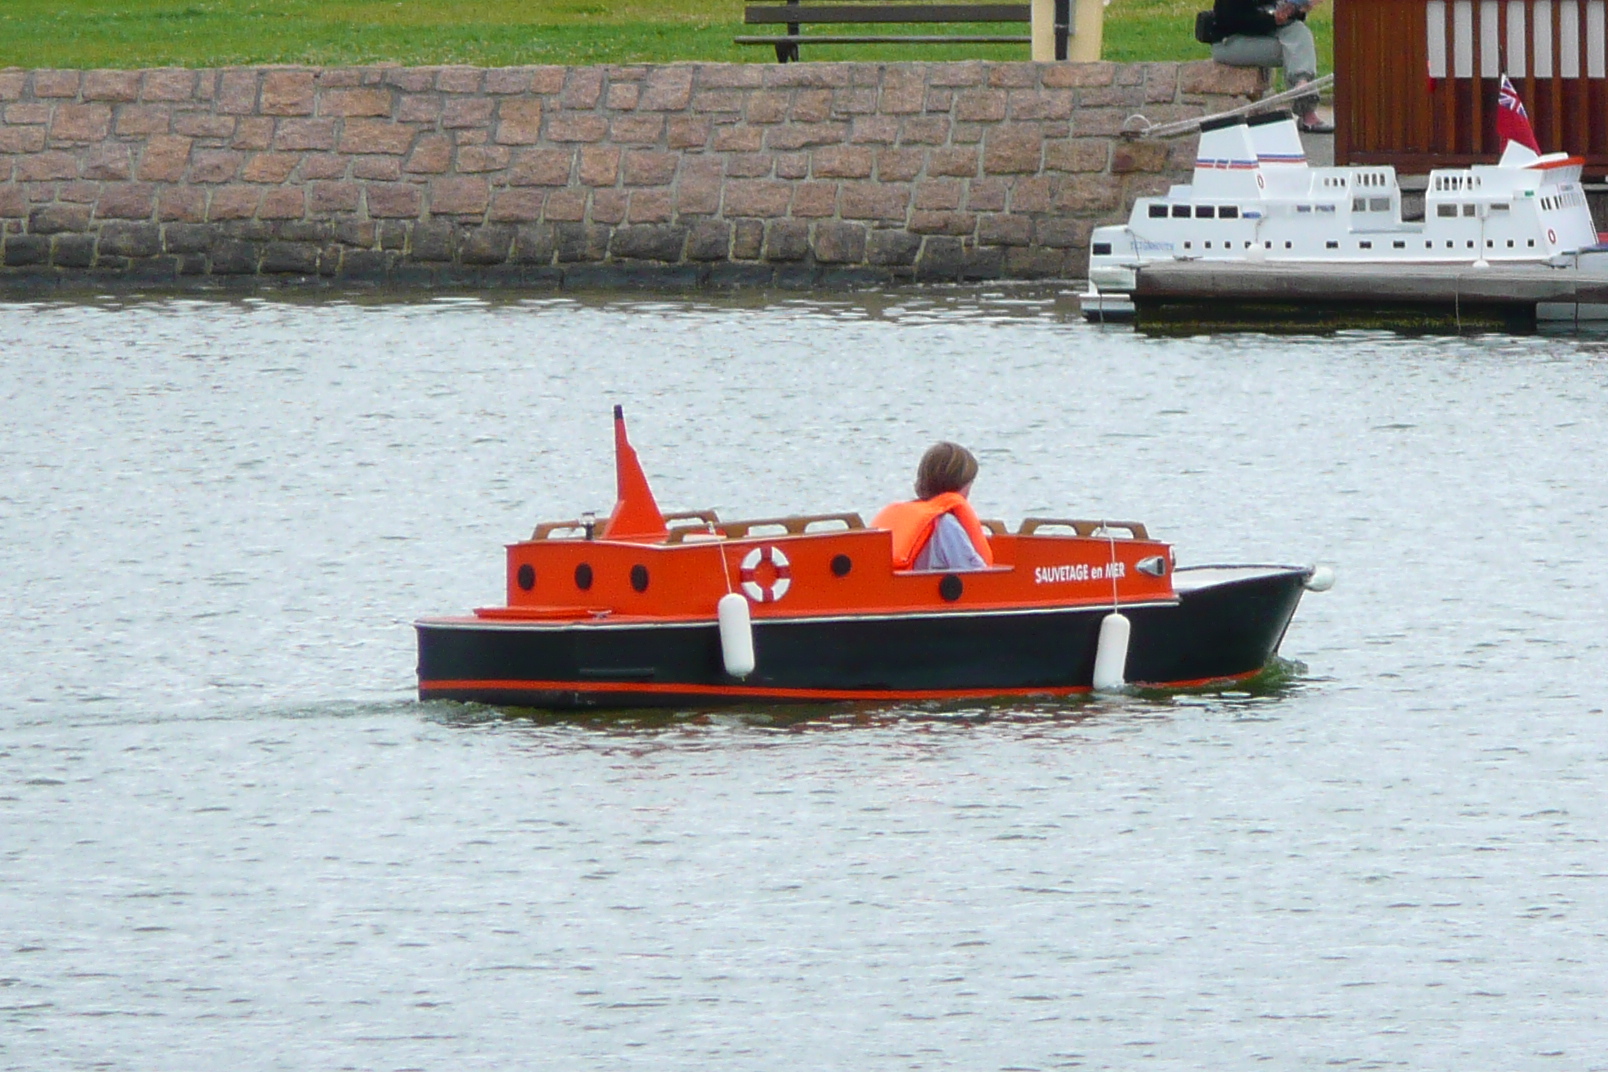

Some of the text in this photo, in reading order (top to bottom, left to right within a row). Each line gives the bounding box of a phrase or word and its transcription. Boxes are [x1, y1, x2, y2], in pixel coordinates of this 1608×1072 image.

[1035, 562, 1125, 583] SAUVETAGE en MER
